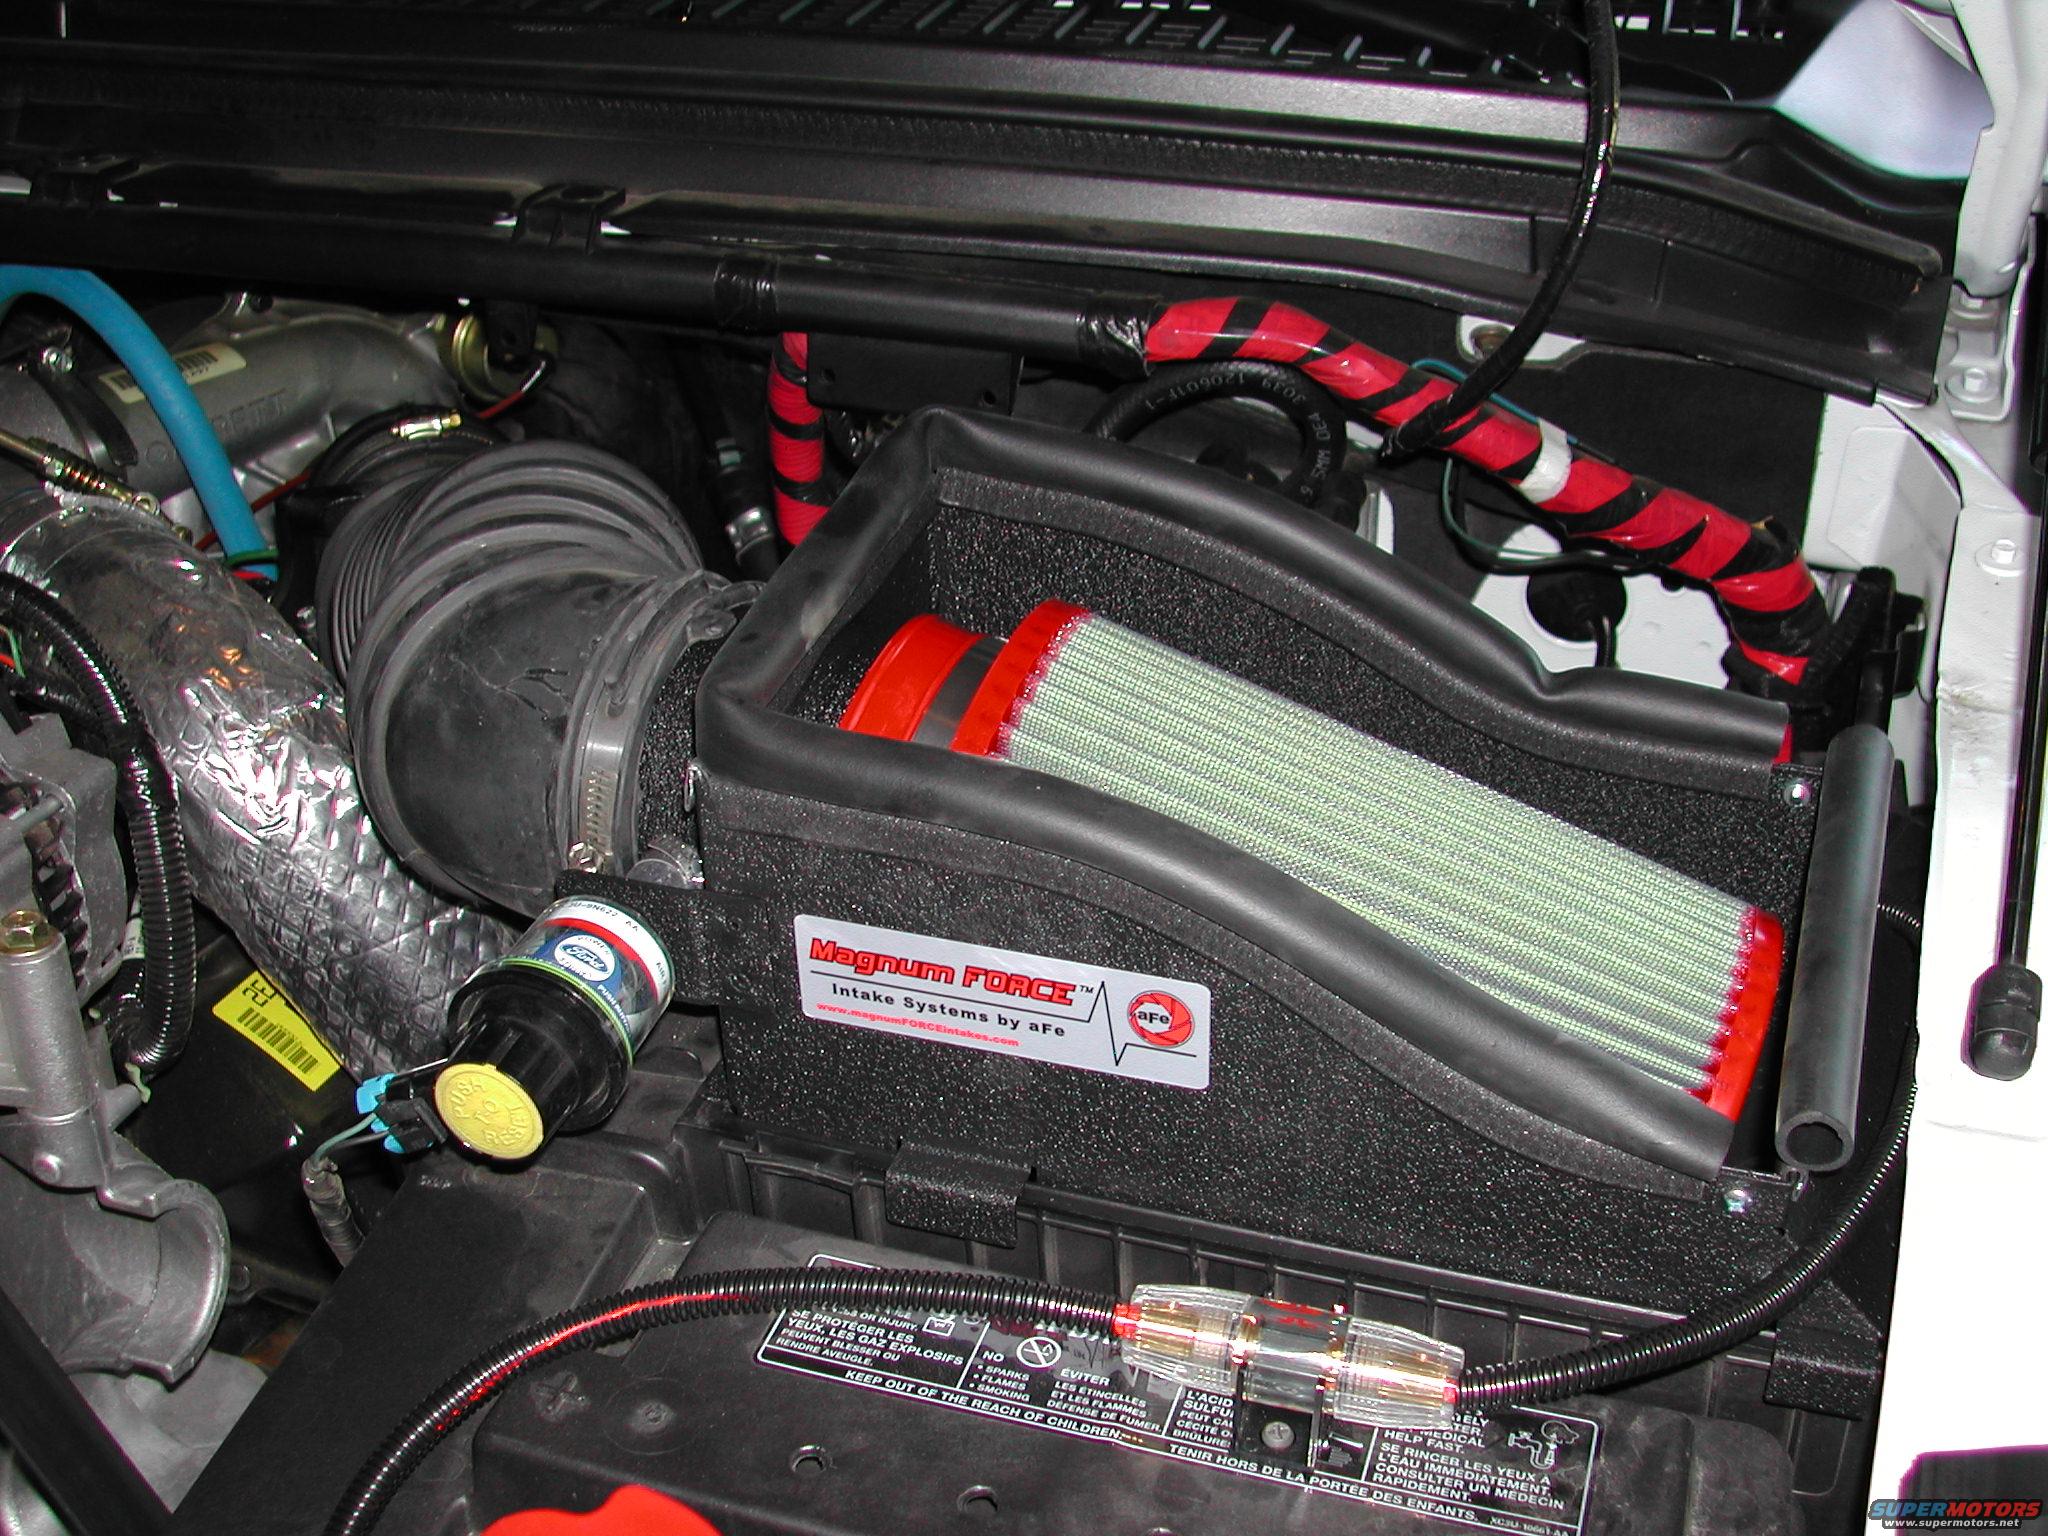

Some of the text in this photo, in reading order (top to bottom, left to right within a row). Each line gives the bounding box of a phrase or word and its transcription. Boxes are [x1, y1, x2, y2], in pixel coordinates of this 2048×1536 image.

[809, 938, 955, 985] Magnum
[961, 965, 1077, 1006] FORCE
[832, 983, 1065, 1038] Intake Systems by aFe
[1136, 1007, 1171, 1026] aFe
[816, 1002, 1020, 1048] www.magnumFORCEintakes.com
[450, 1077, 485, 1119] PUSH
[475, 1100, 498, 1126] TO
[791, 1310, 915, 1343] SE PROTÉGER LES
[859, 1312, 919, 1331] OR INJURY.
[775, 1337, 874, 1367] RENDRE AVEUGLE.
[780, 1327, 901, 1361] PEUVENT BLESSER OU
[787, 1318, 965, 1365] YEUX, LES GAZ EXPLOSIFS
[982, 1351, 1005, 1363] NO
[981, 1374, 1027, 1391] FLAMES
[985, 1365, 1030, 1381] SPARKS
[1060, 1366, 1111, 1386] ÉVITER
[976, 1383, 1031, 1402] SMOKING
[1051, 1390, 1147, 1418] ET LES FLAMMES
[1054, 1381, 1146, 1407] LES ÉTINCELLES
[1187, 1390, 1233, 1408] L'ACID
[1046, 1399, 1163, 1432] DÉFENSE DE FUMER.
[1179, 1410, 1210, 1423] PEUT
[1183, 1400, 1234, 1418] SULFU
[1176, 1418, 1219, 1436] CÉCITÉ
[1419, 1429, 1486, 1448] MEDICAL
[845, 1369, 1480, 1522] KEEP OUT OF THE REACH OF CHILDREN. TENIR HORS DE LA PORTÉE DES ENFANTS.
[1383, 1430, 1466, 1454] HELP FAST.
[1377, 1452, 1552, 1497] L'EAU IMMEDIATEMENT.
[1380, 1443, 1402, 1453] SE
[1464, 1459, 1492, 1473] LES
[1497, 1466, 1537, 1482] YEUX
[1372, 1473, 1473, 1503] RAPIDEMENT.
[1375, 1463, 1566, 1511] CONSULTER UN MEDECIN
